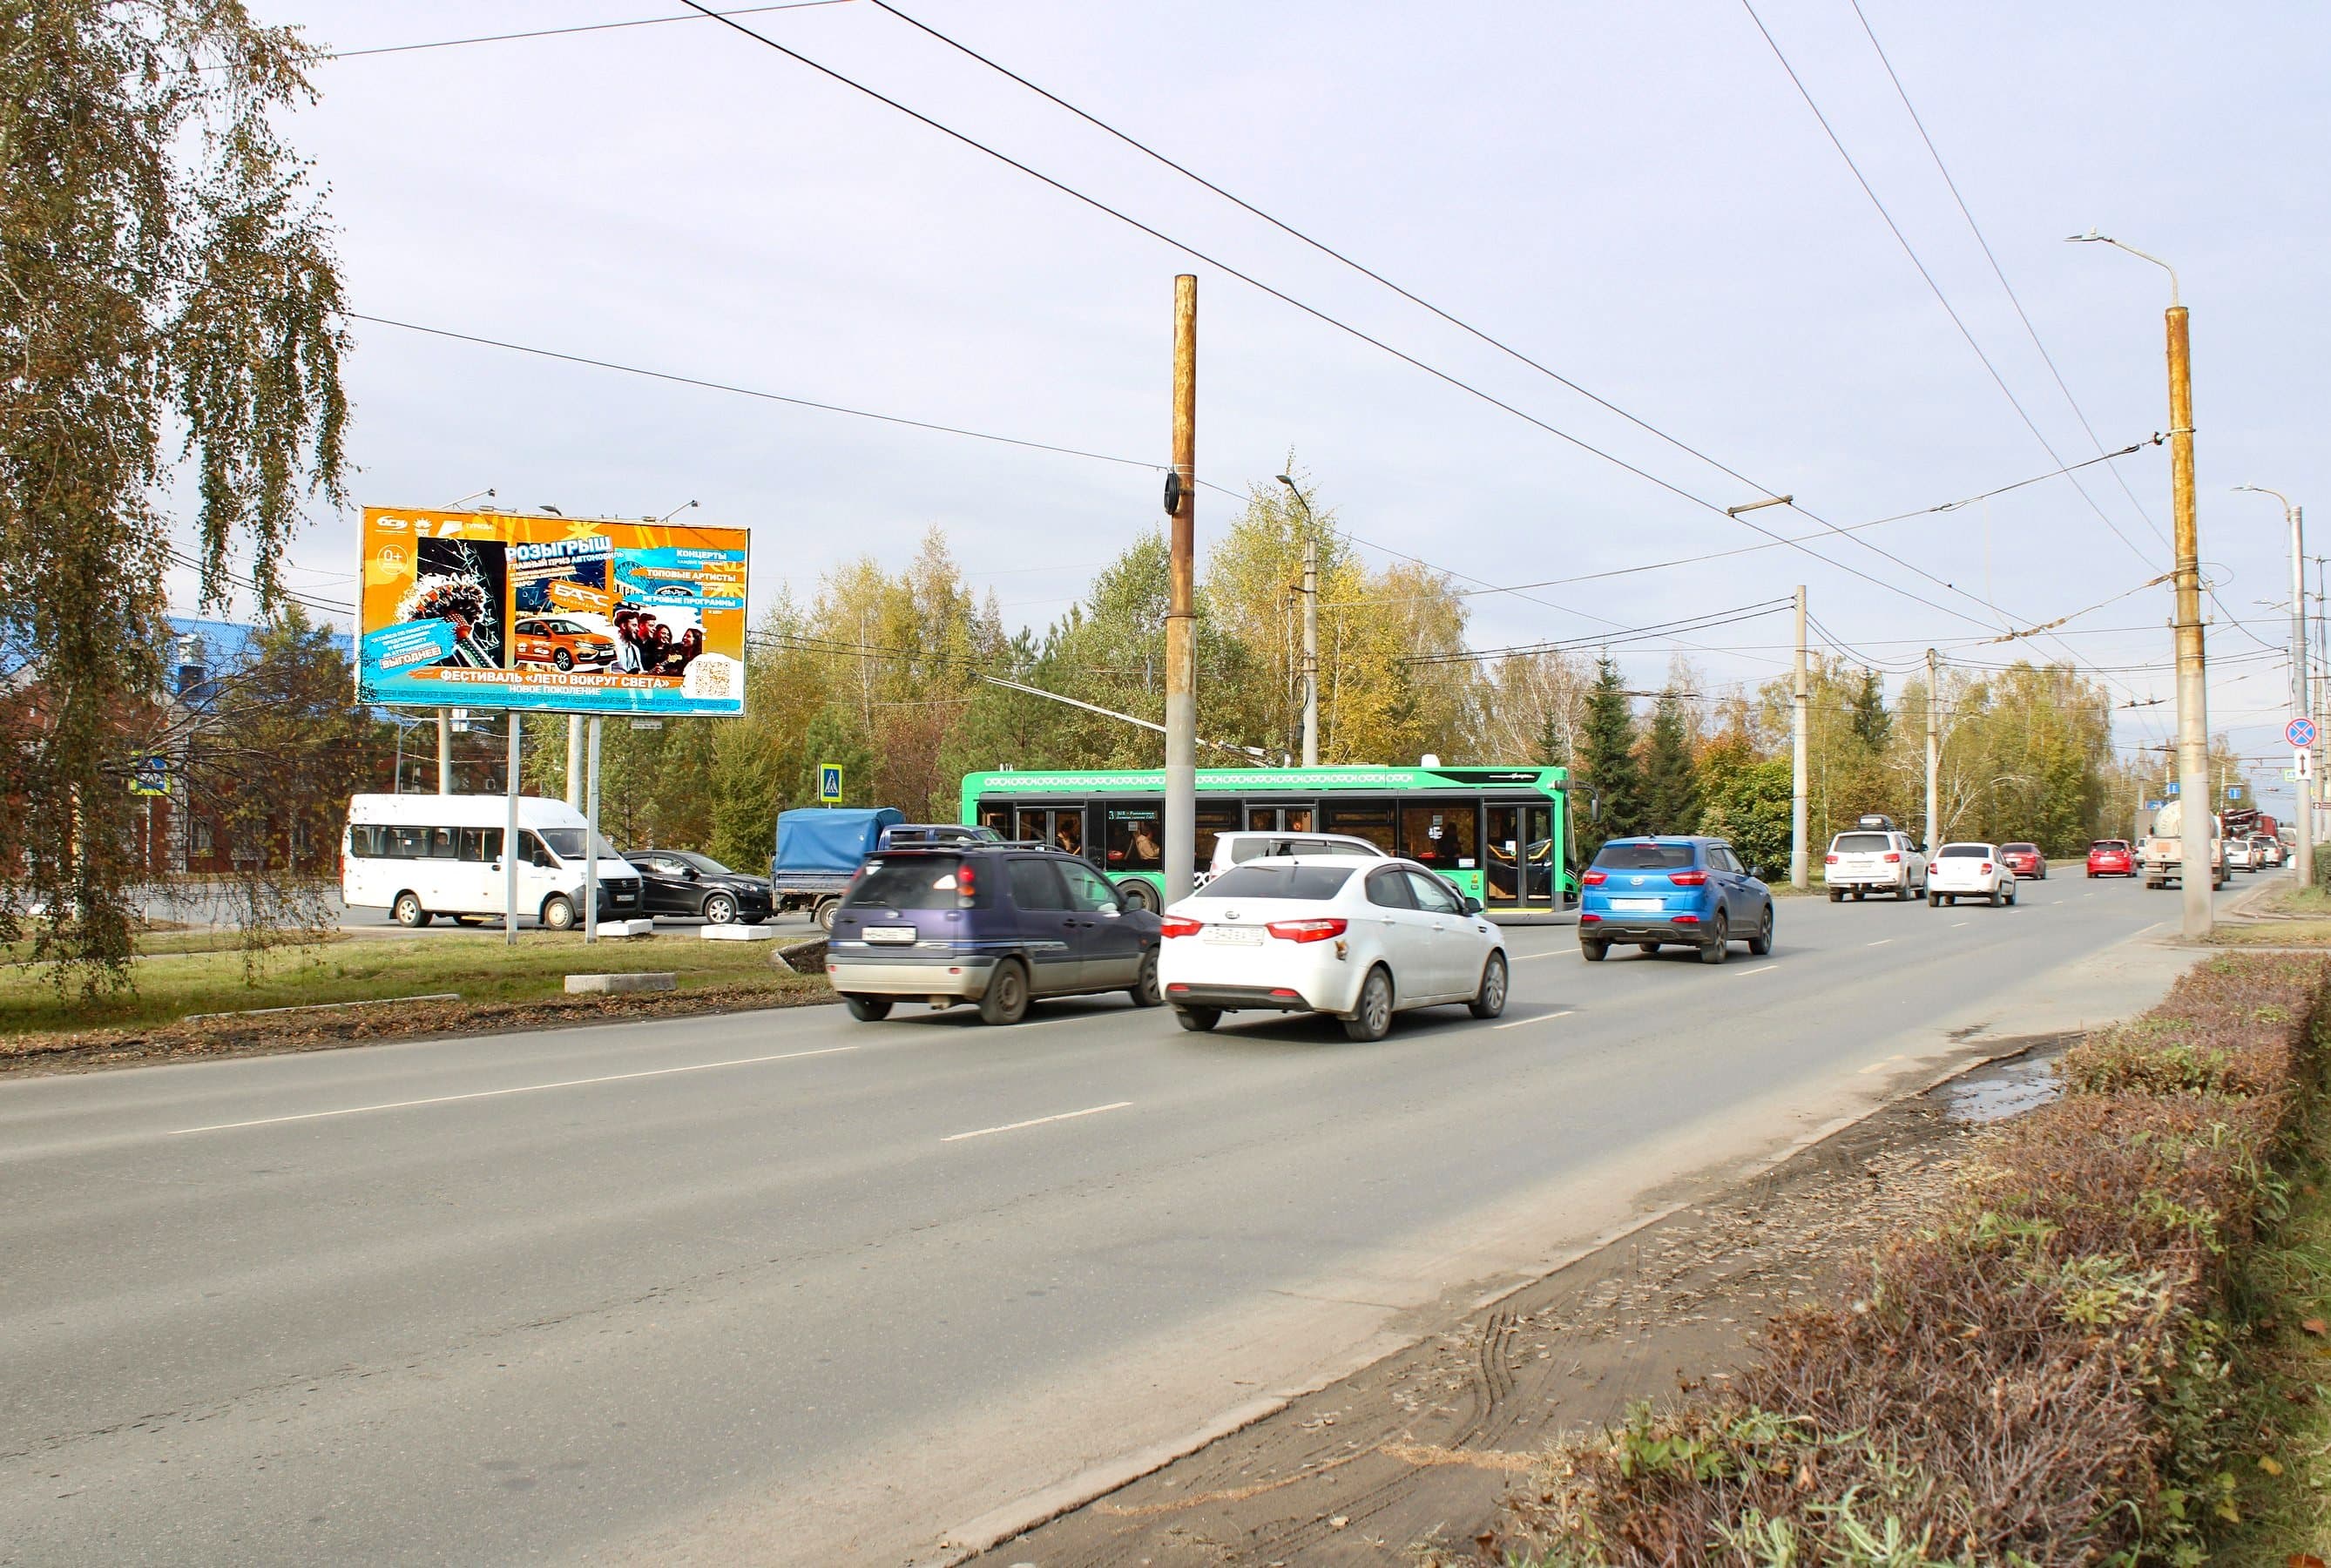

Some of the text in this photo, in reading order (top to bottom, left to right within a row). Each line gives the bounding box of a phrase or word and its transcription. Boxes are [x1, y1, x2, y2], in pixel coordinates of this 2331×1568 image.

[383, 550, 402, 559] 0+
[504, 537, 611, 562] РОЗЫГРЫШ
[676, 549, 726, 560] КОНЦЕРТЫ
[508, 558, 548, 571] ГЛАВНЫЙ
[548, 558, 571, 567] ПРИЗ
[571, 551, 625, 564] АВТОМОБИЛЬ
[647, 568, 736, 583] ТОПОВЫЕ АРТИСТЫ
[642, 595, 736, 608] ИГРОВЫЕ ПРОГРАММЫ
[380, 645, 443, 670] ВЫГОДНЕЕ!
[440, 670, 670, 687] ФЕСТИВАЛЬ «ЛЕТО ВОКРУГ СВЕТА»
[509, 685, 602, 696] НОВОЕ ПОКОЛЕНИЕ
[1108, 810, 1115, 820] 3
